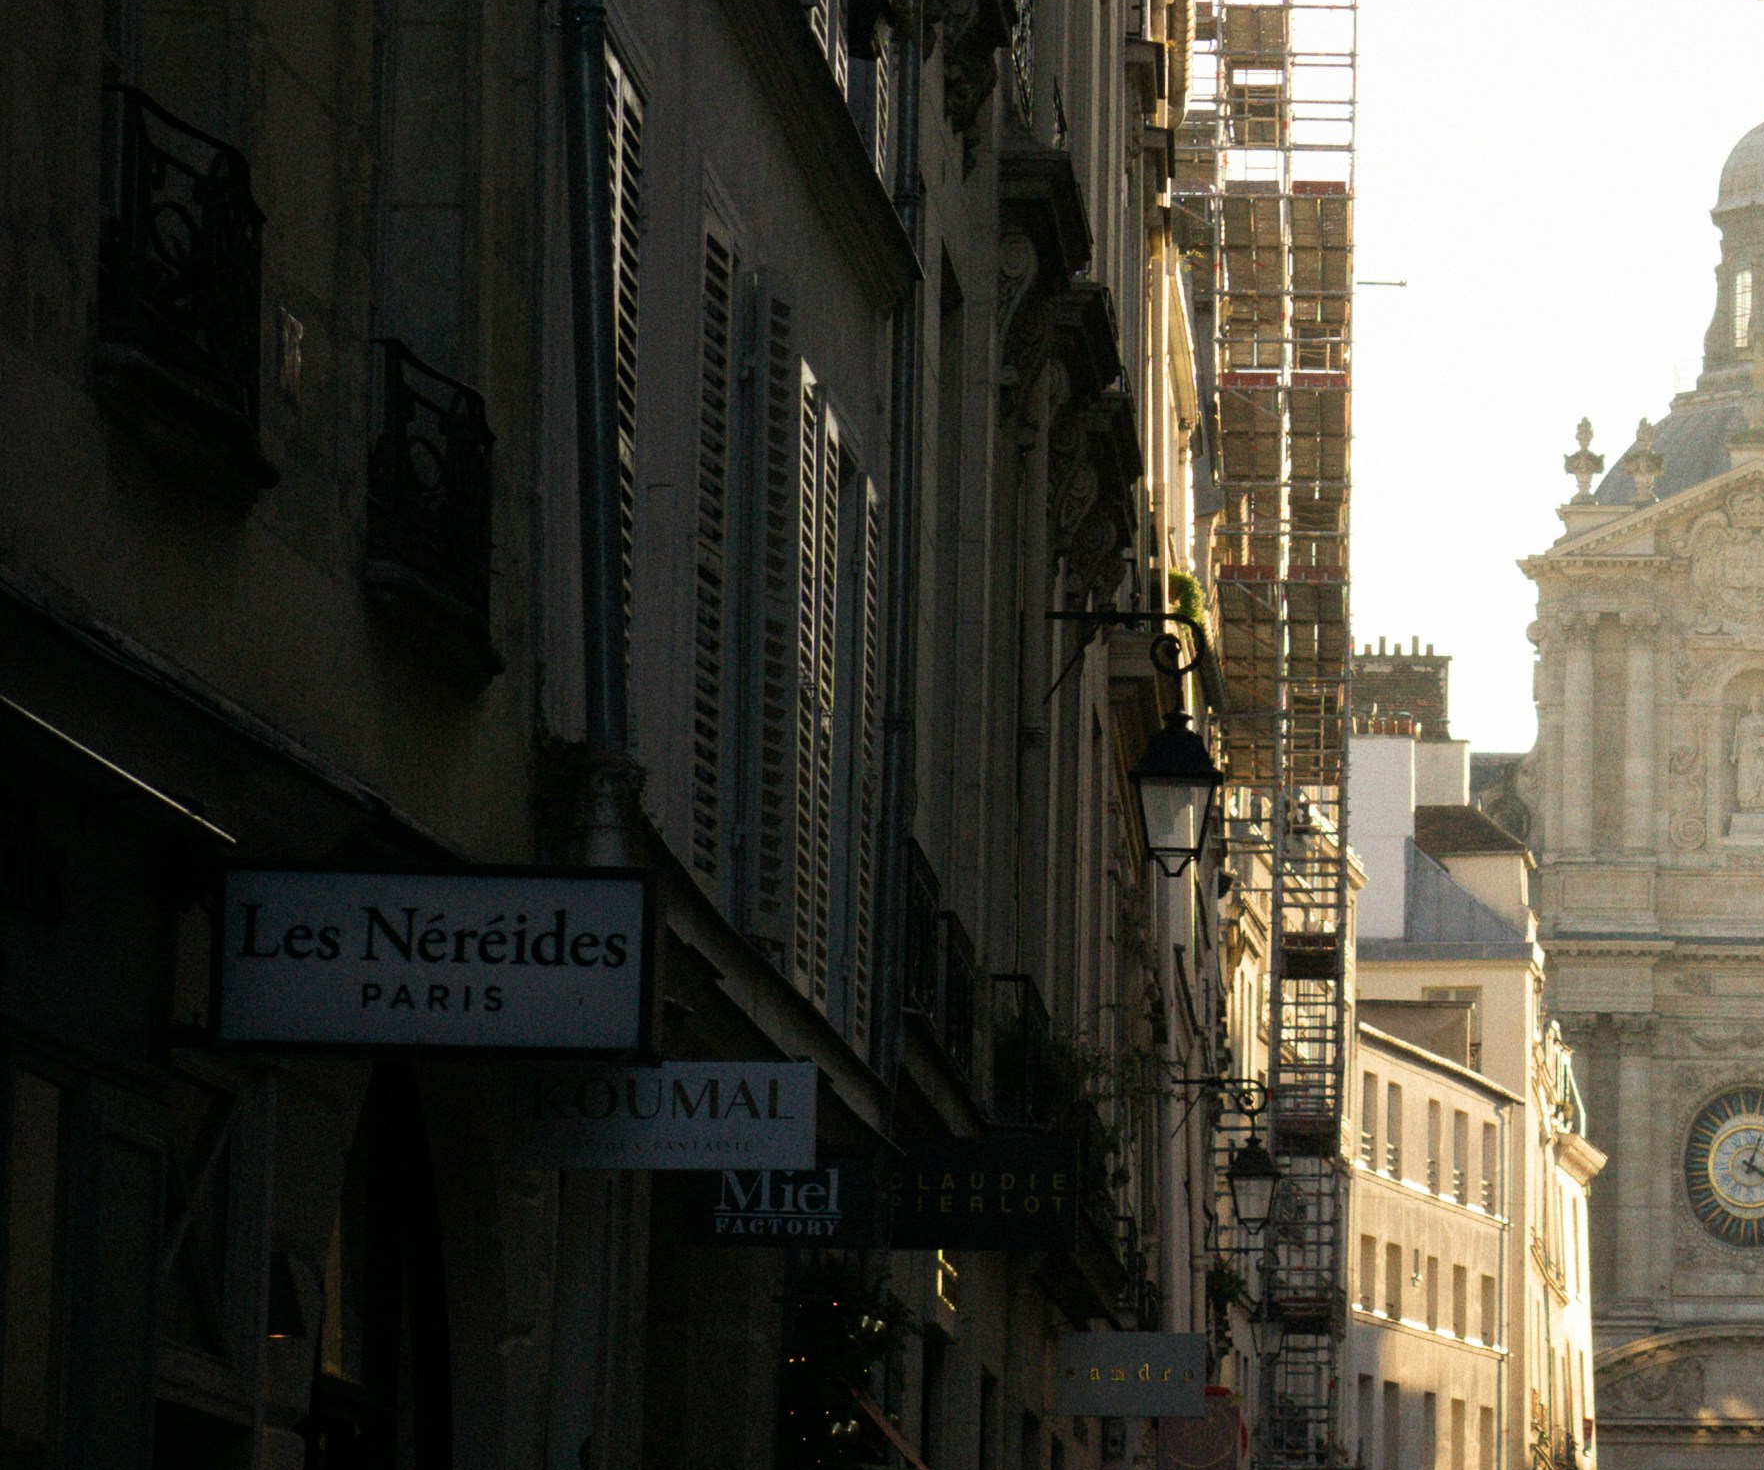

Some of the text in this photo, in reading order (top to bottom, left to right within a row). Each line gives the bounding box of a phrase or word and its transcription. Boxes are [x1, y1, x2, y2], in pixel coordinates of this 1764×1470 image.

[238, 902, 628, 967] Les Néréides
[361, 983, 503, 1012] PARIS
[531, 1076, 795, 1120] KOUMAL
[714, 1168, 842, 1212] Miel
[714, 1217, 841, 1236] FACTORY
